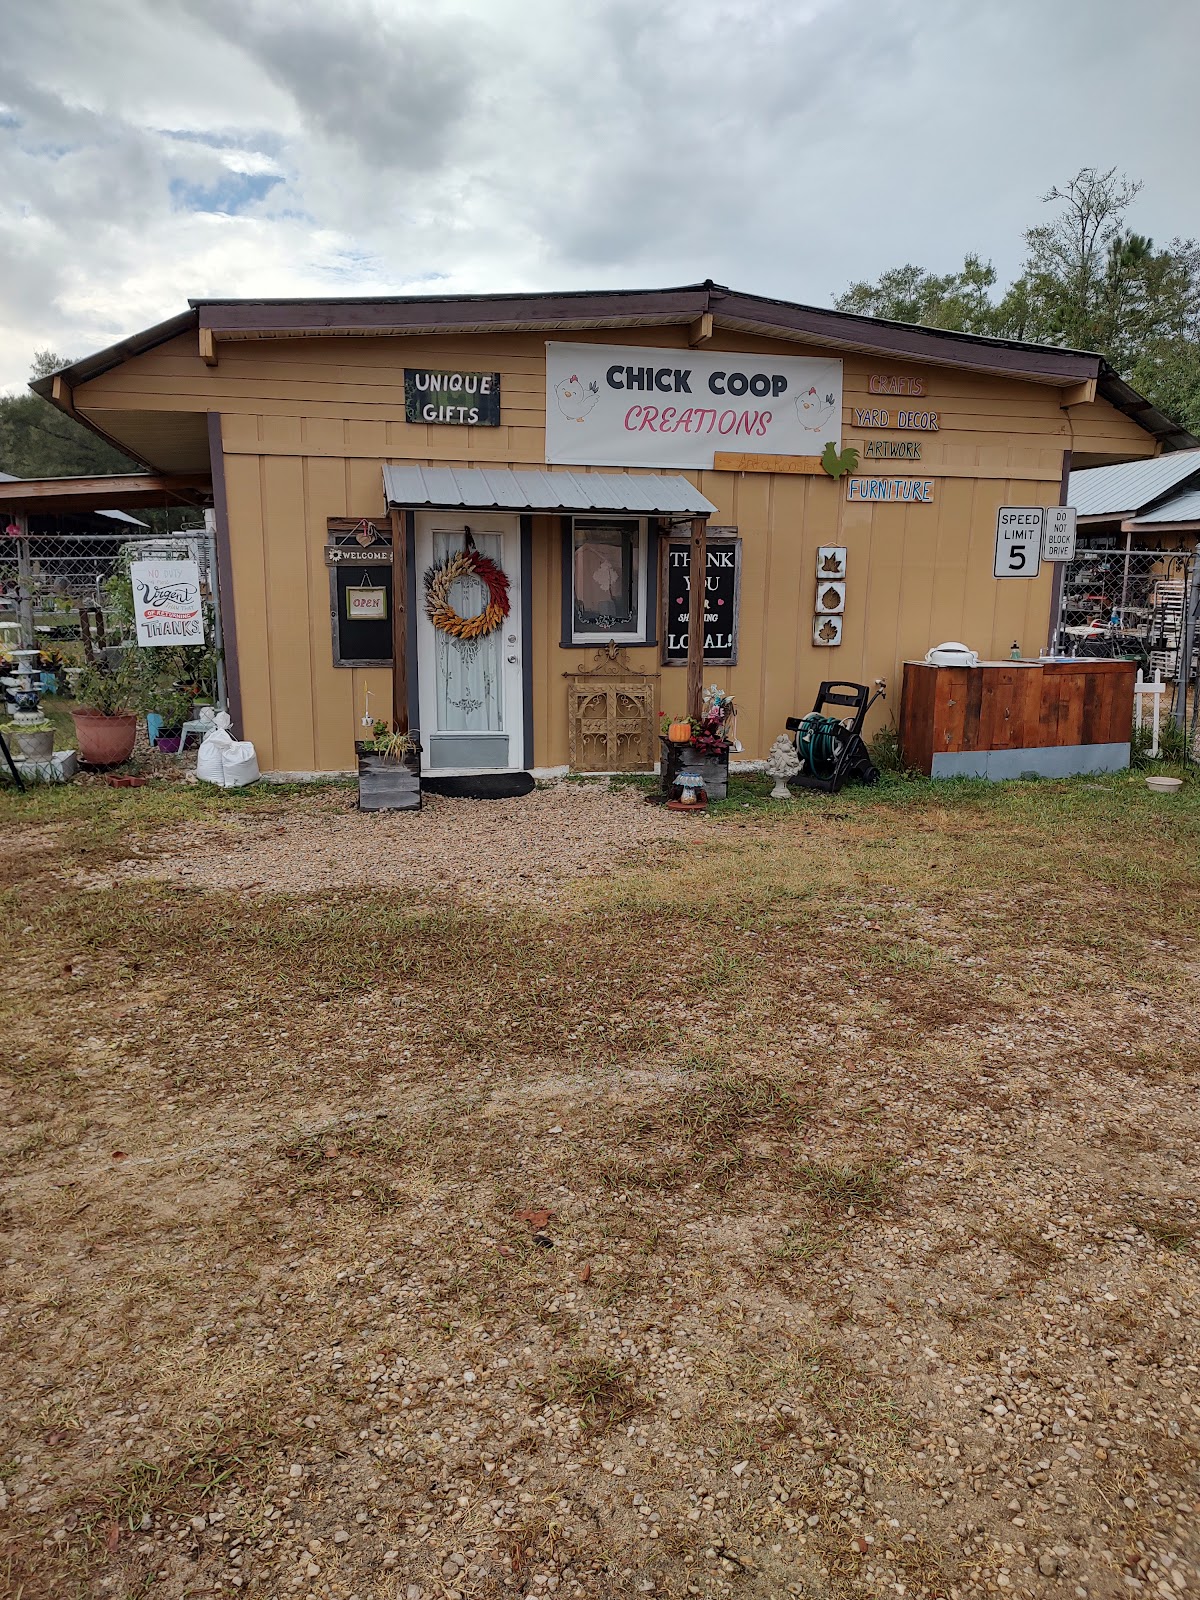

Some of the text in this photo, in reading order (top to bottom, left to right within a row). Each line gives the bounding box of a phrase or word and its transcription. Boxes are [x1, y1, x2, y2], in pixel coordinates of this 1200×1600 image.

[415, 373, 492, 395] UNIQUE
[606, 365, 788, 398] CHICK COOP
[869, 374, 924, 396] CRAFTS
[422, 403, 480, 424] GIFTS
[624, 405, 773, 437] CREATIONS
[855, 408, 939, 431] YARD DECOR
[865, 441, 922, 459] ARTWORK
[849, 479, 934, 501] FURNITURE
[1001, 514, 1040, 525] SPEED
[1056, 512, 1067, 522] DO
[1004, 529, 1035, 540] LIMIT
[1053, 524, 1068, 533] NOT
[1048, 535, 1071, 544] BLOCK
[342, 551, 387, 560] WELCOME
[1008, 545, 1026, 570] 5
[1048, 546, 1069, 555] DRIVE
[670, 552, 734, 568] THNK
[147, 568, 183, 579] NO DUTY
[683, 575, 721, 591] YU
[352, 598, 381, 608] OPEN
[667, 634, 733, 650] LOAL!
